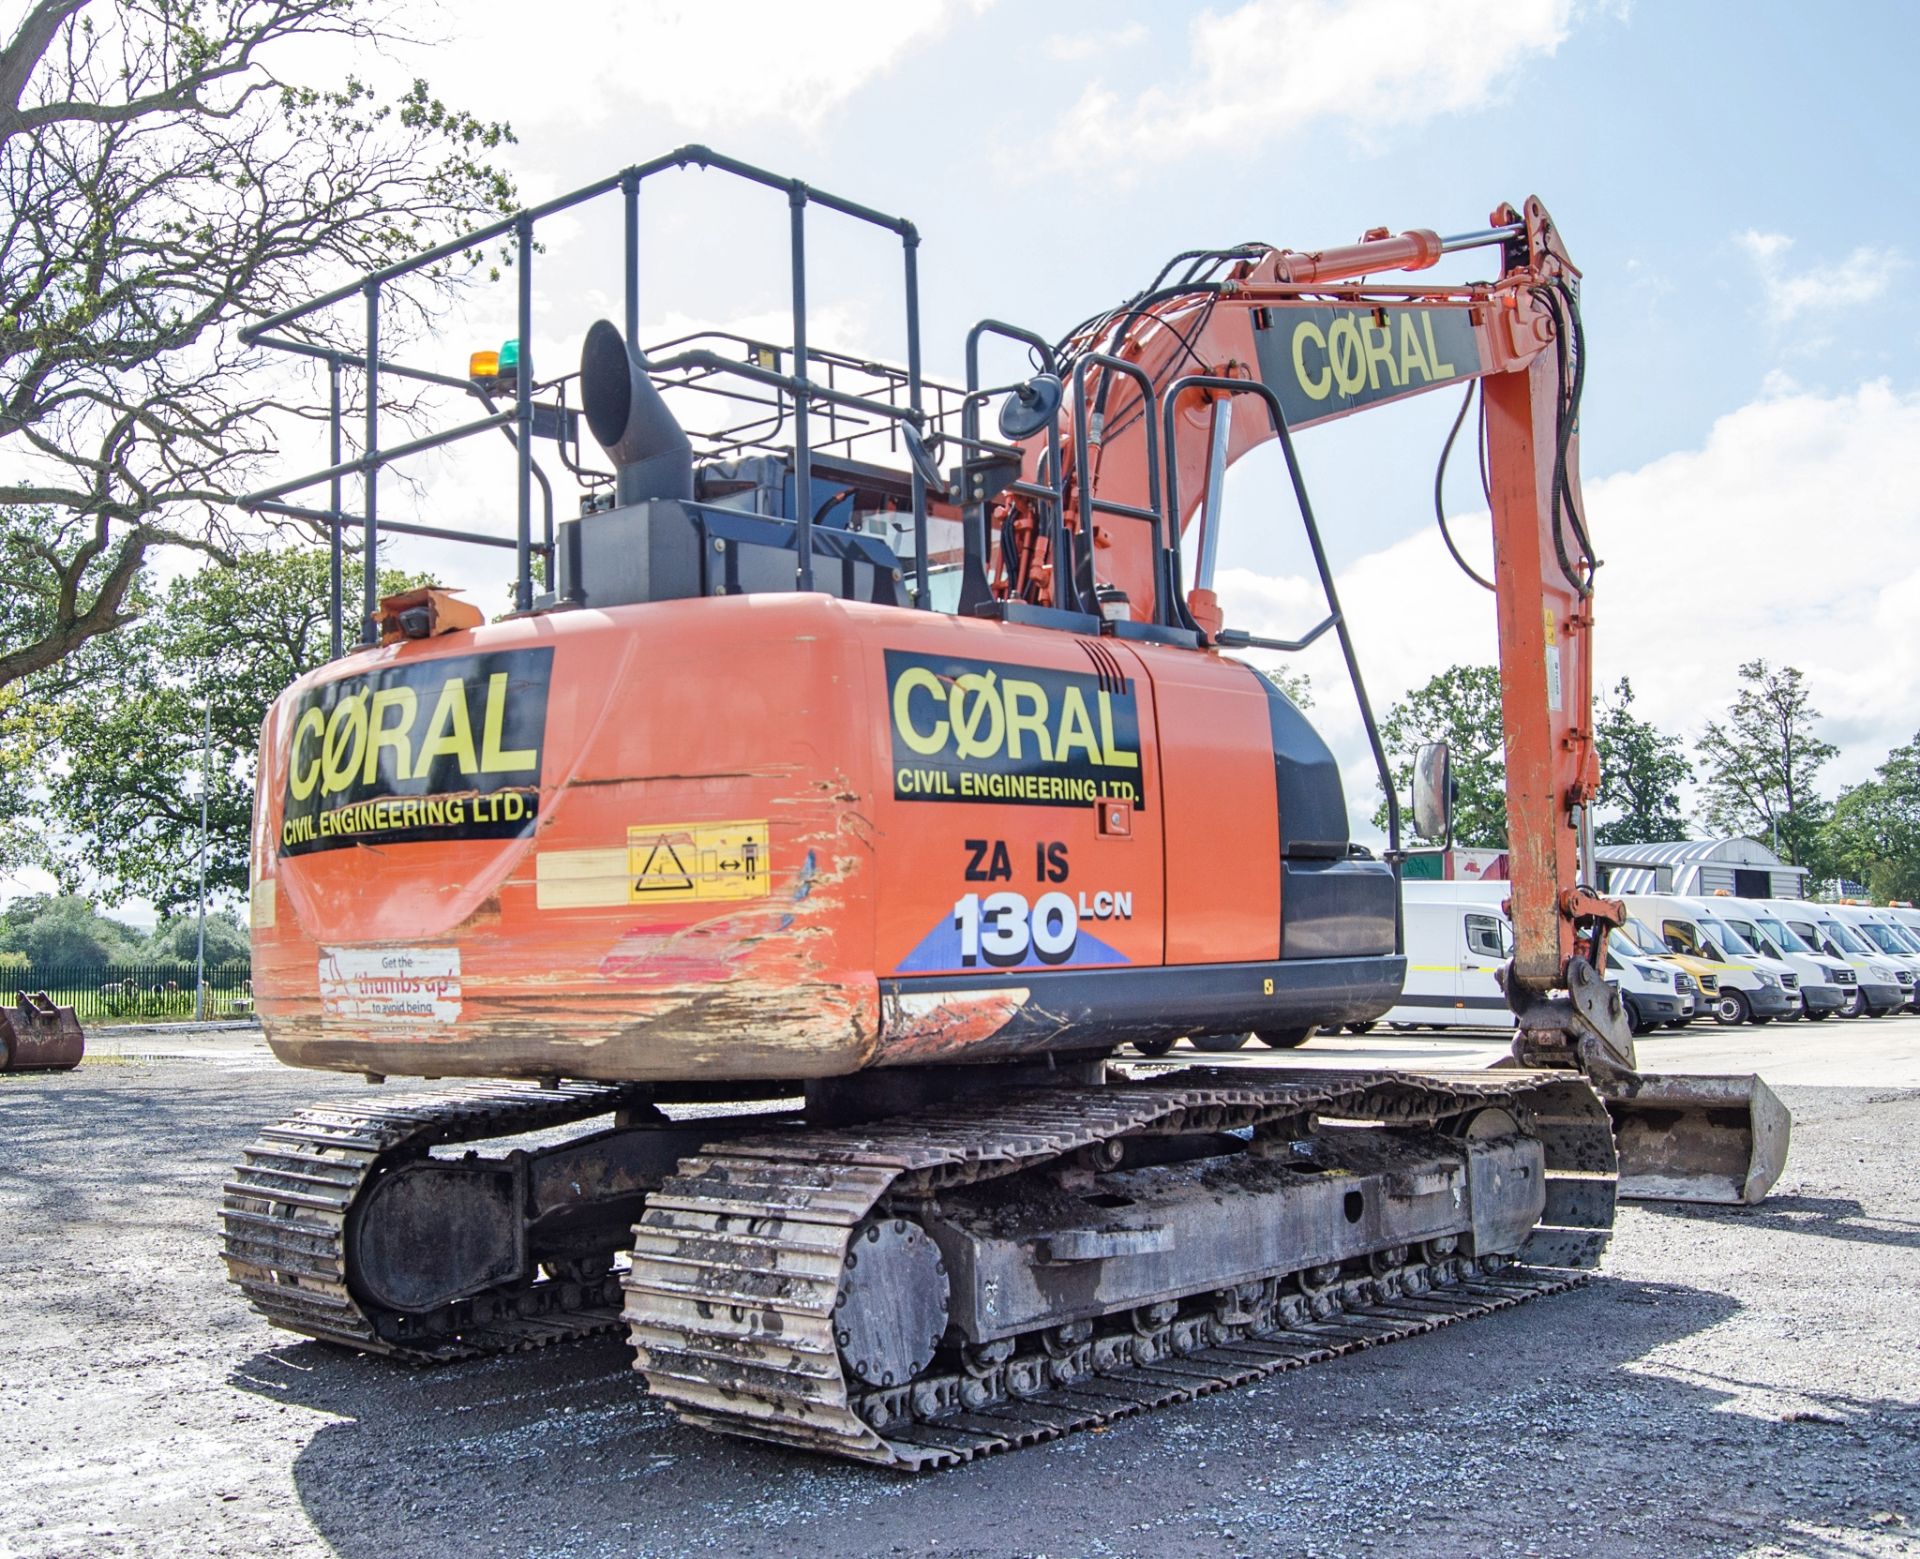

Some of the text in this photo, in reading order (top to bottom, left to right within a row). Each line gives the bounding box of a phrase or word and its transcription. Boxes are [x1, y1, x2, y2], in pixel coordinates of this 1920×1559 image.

[897, 769, 955, 795] CIVIL
[960, 772, 1097, 802] ENGINEERING
[283, 792, 533, 846] CIVIL ENGINEERING LTD.
[954, 890, 1132, 966] 130 LCN
[382, 956, 413, 969] Get the
[372, 1002, 432, 1013] to avoid being
